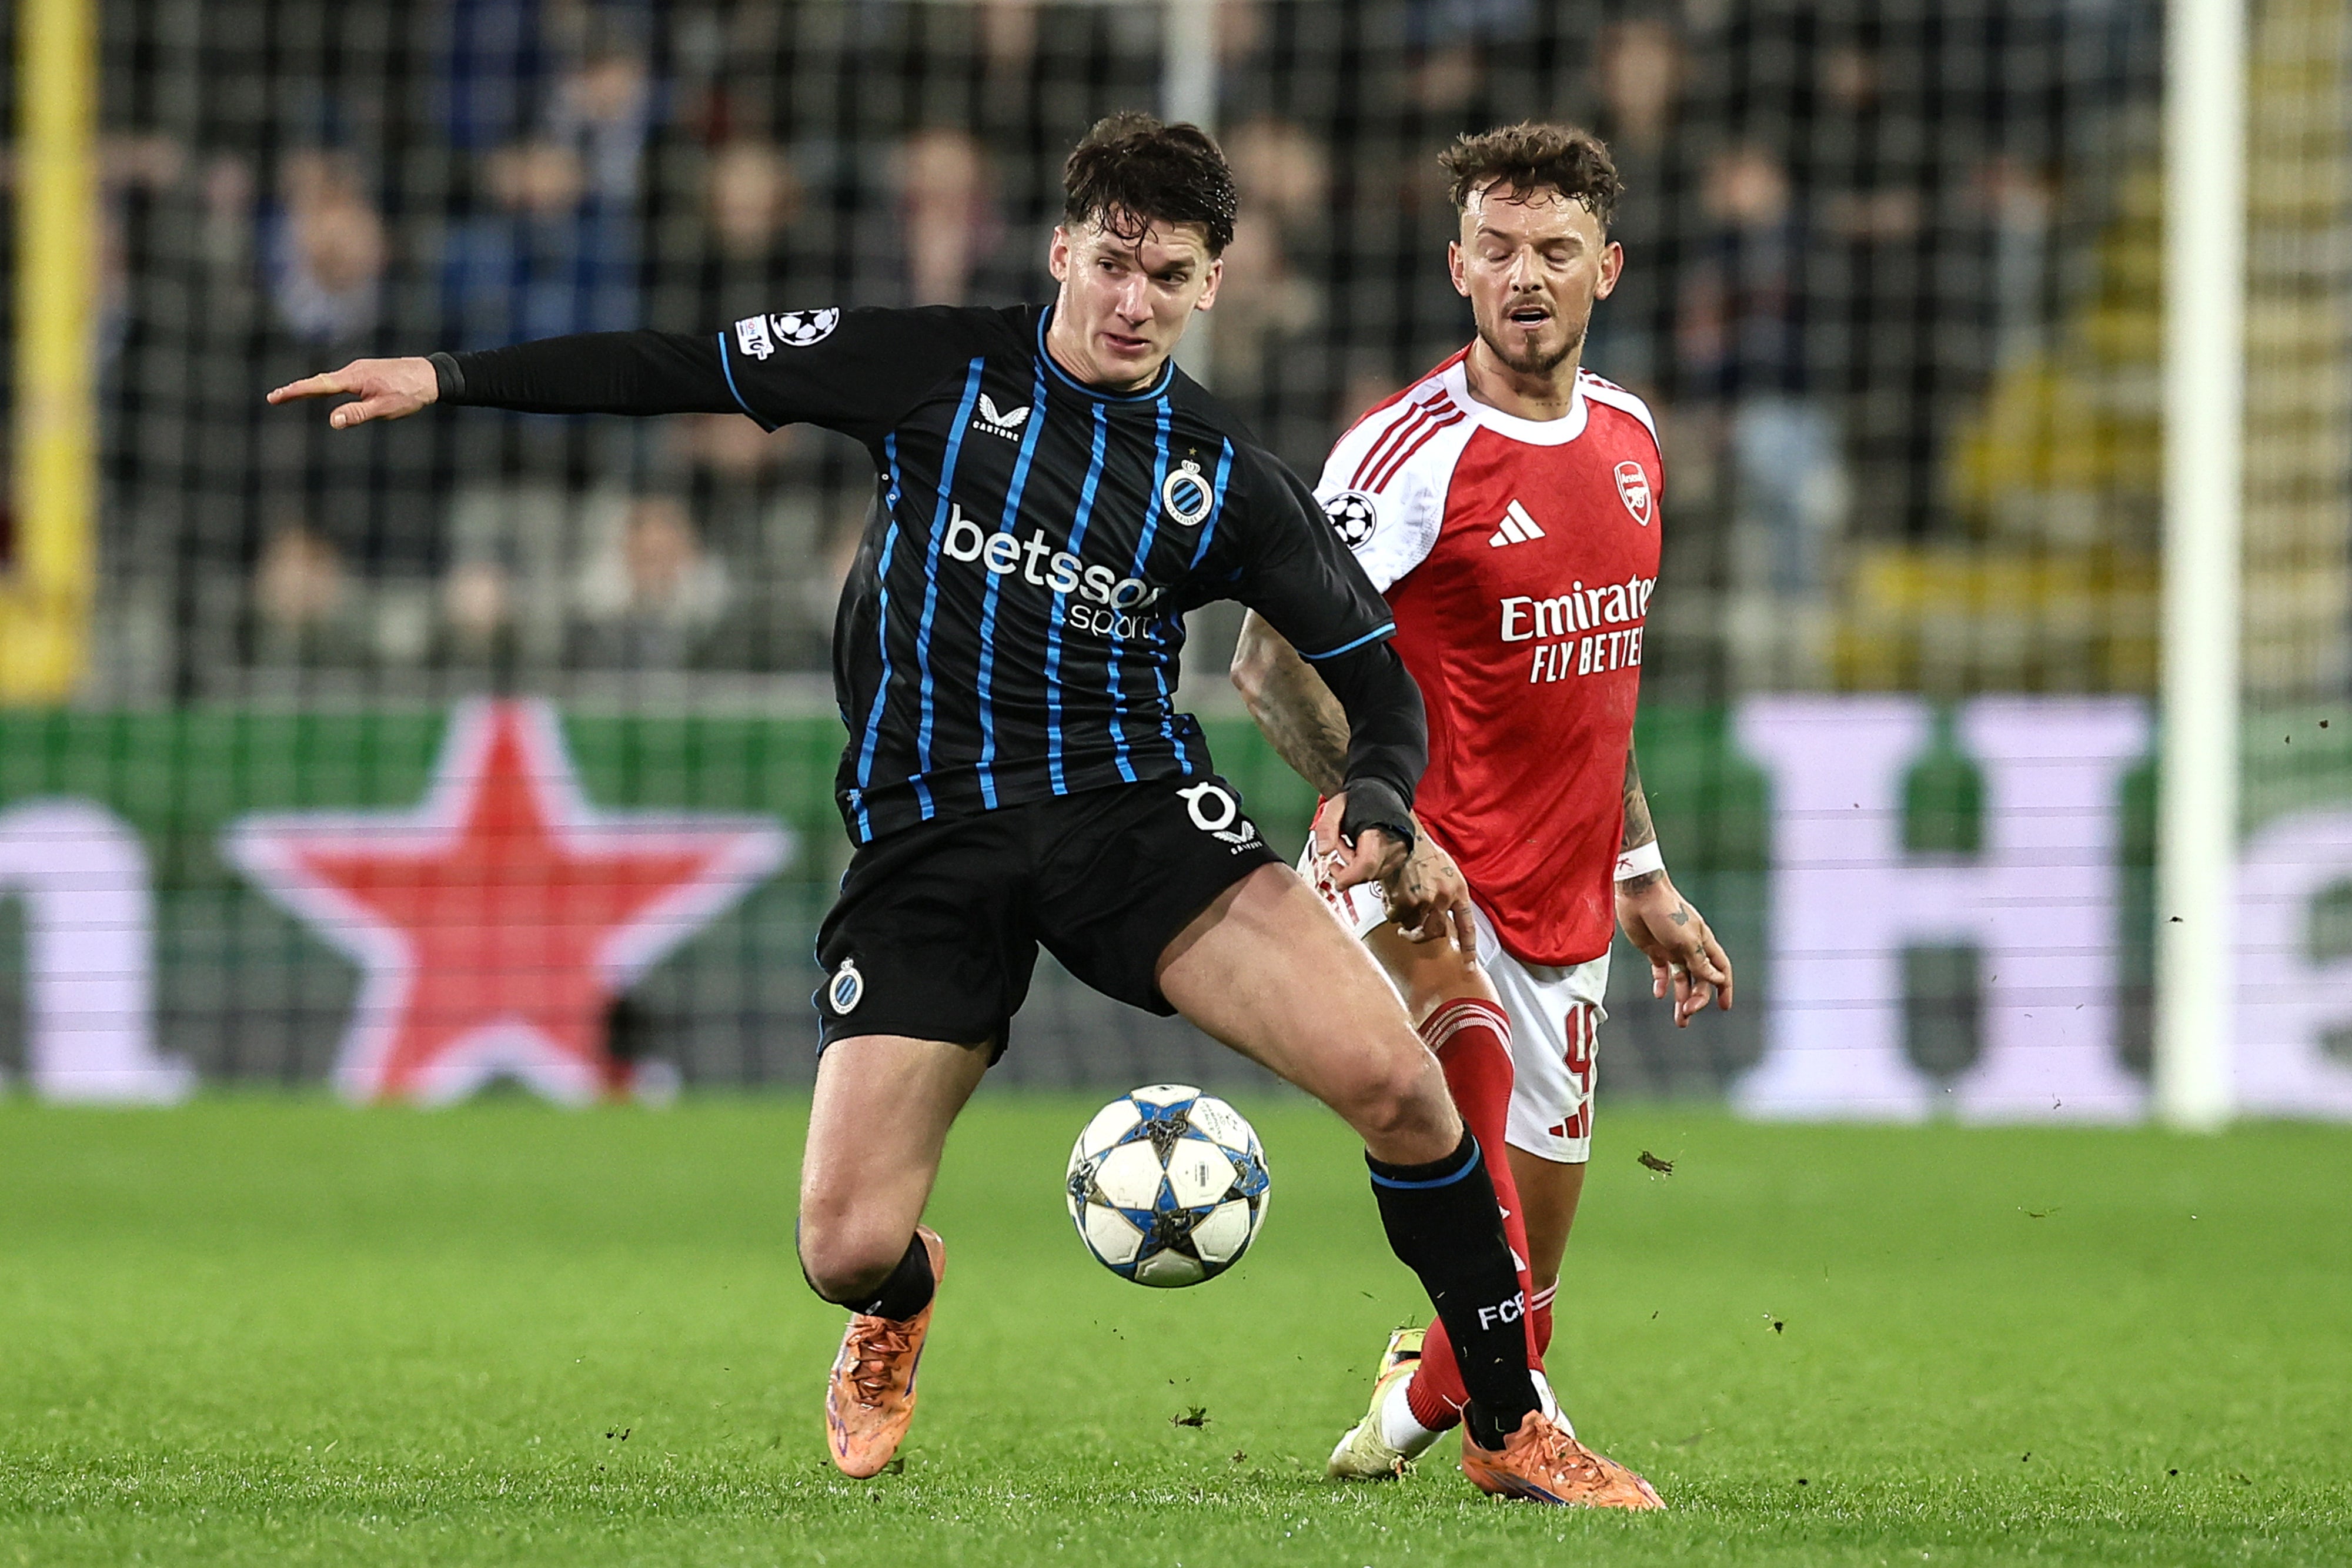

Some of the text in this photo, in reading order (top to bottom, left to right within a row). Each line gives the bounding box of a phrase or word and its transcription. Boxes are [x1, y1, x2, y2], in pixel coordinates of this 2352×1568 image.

[973, 420, 1019, 442] CASTORE
[1500, 573, 1657, 642] Emirate
[1530, 641, 1574, 684] FLY
[1562, 1002, 1596, 1096] 4
